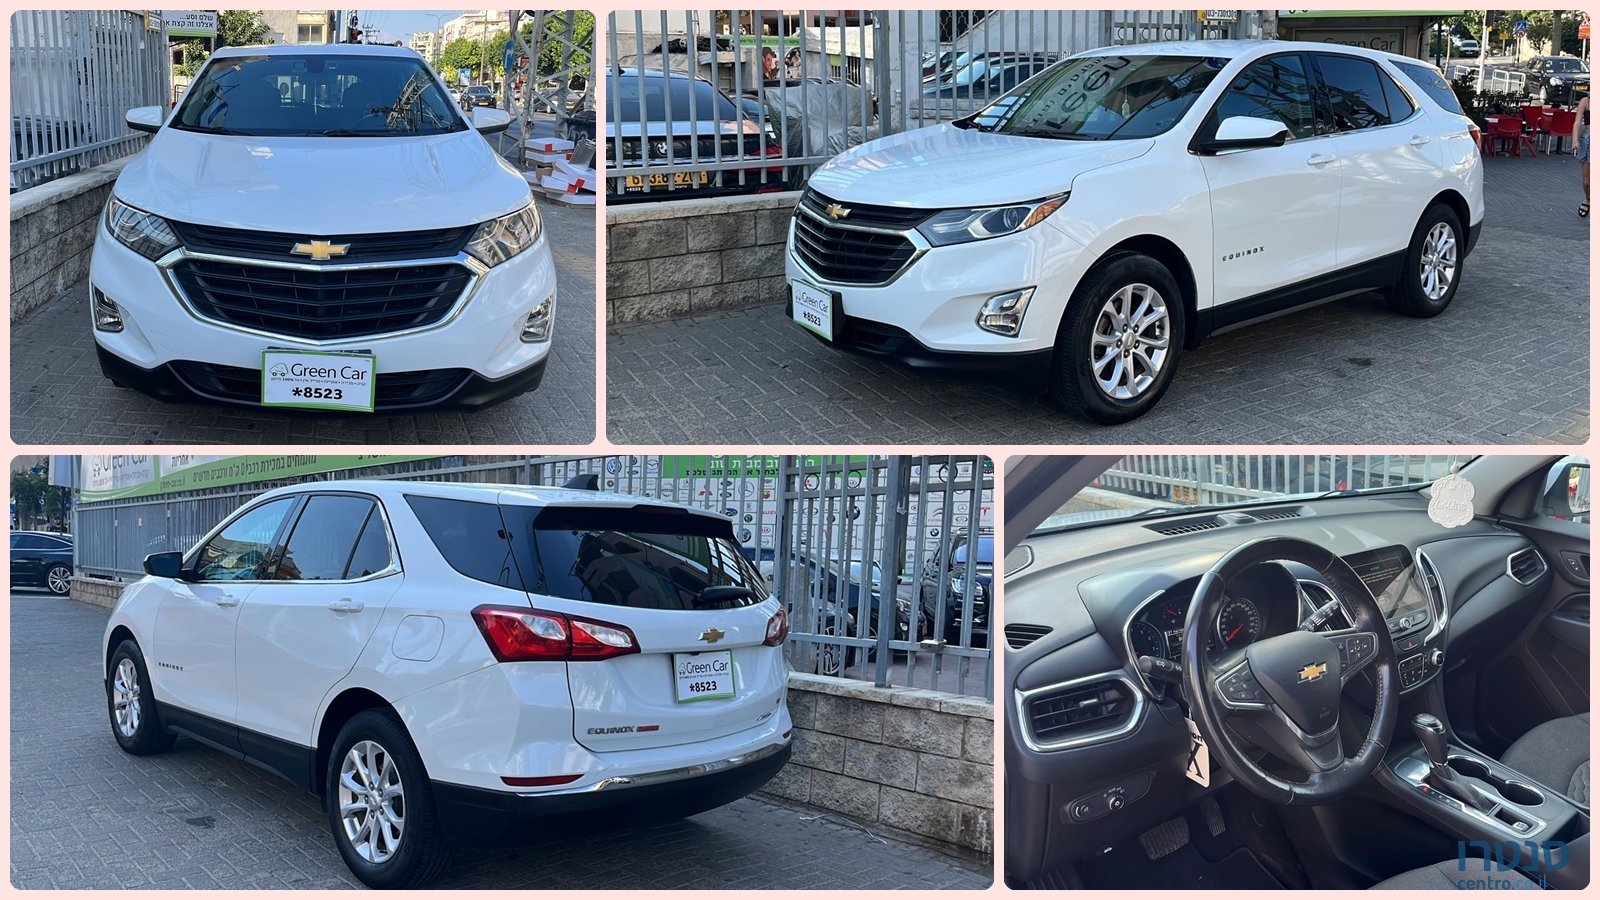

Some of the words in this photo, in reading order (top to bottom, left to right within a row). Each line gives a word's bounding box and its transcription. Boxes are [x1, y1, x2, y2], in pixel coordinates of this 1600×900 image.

[1222, 246, 1264, 262] EQUINOX
[802, 292, 818, 309] Green
[291, 363, 337, 379] Green
[340, 366, 367, 381] Car
[686, 662, 711, 674] Green
[713, 660, 728, 671] Car
[587, 725, 635, 735] EQUINOX
